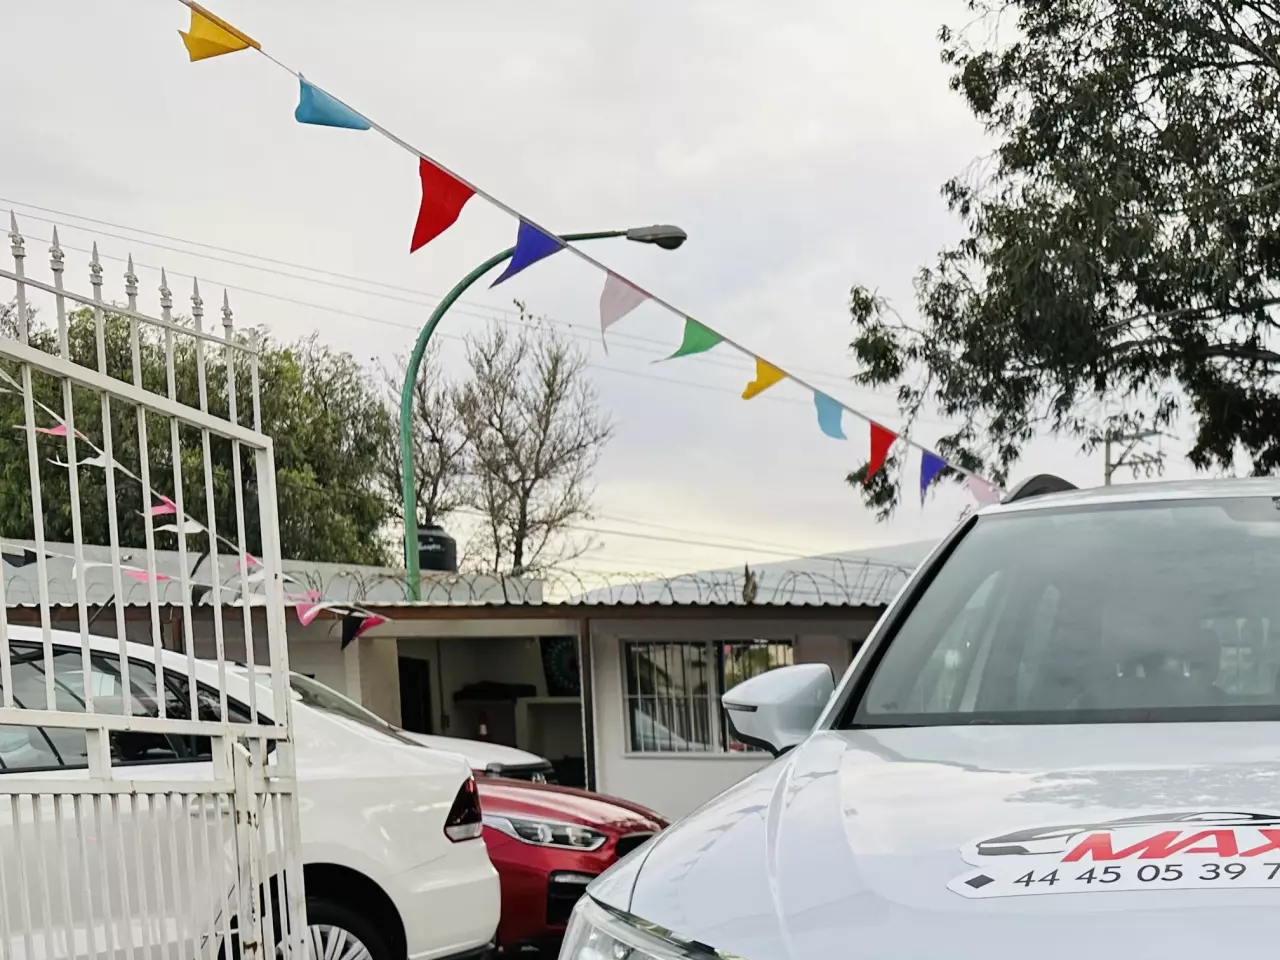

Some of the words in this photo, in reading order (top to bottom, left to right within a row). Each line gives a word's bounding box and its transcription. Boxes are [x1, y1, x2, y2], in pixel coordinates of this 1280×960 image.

[1013, 869, 1060, 887] 44
[1075, 865, 1122, 883] 45
[1137, 863, 1183, 882] 05
[1199, 862, 1246, 881] 39
